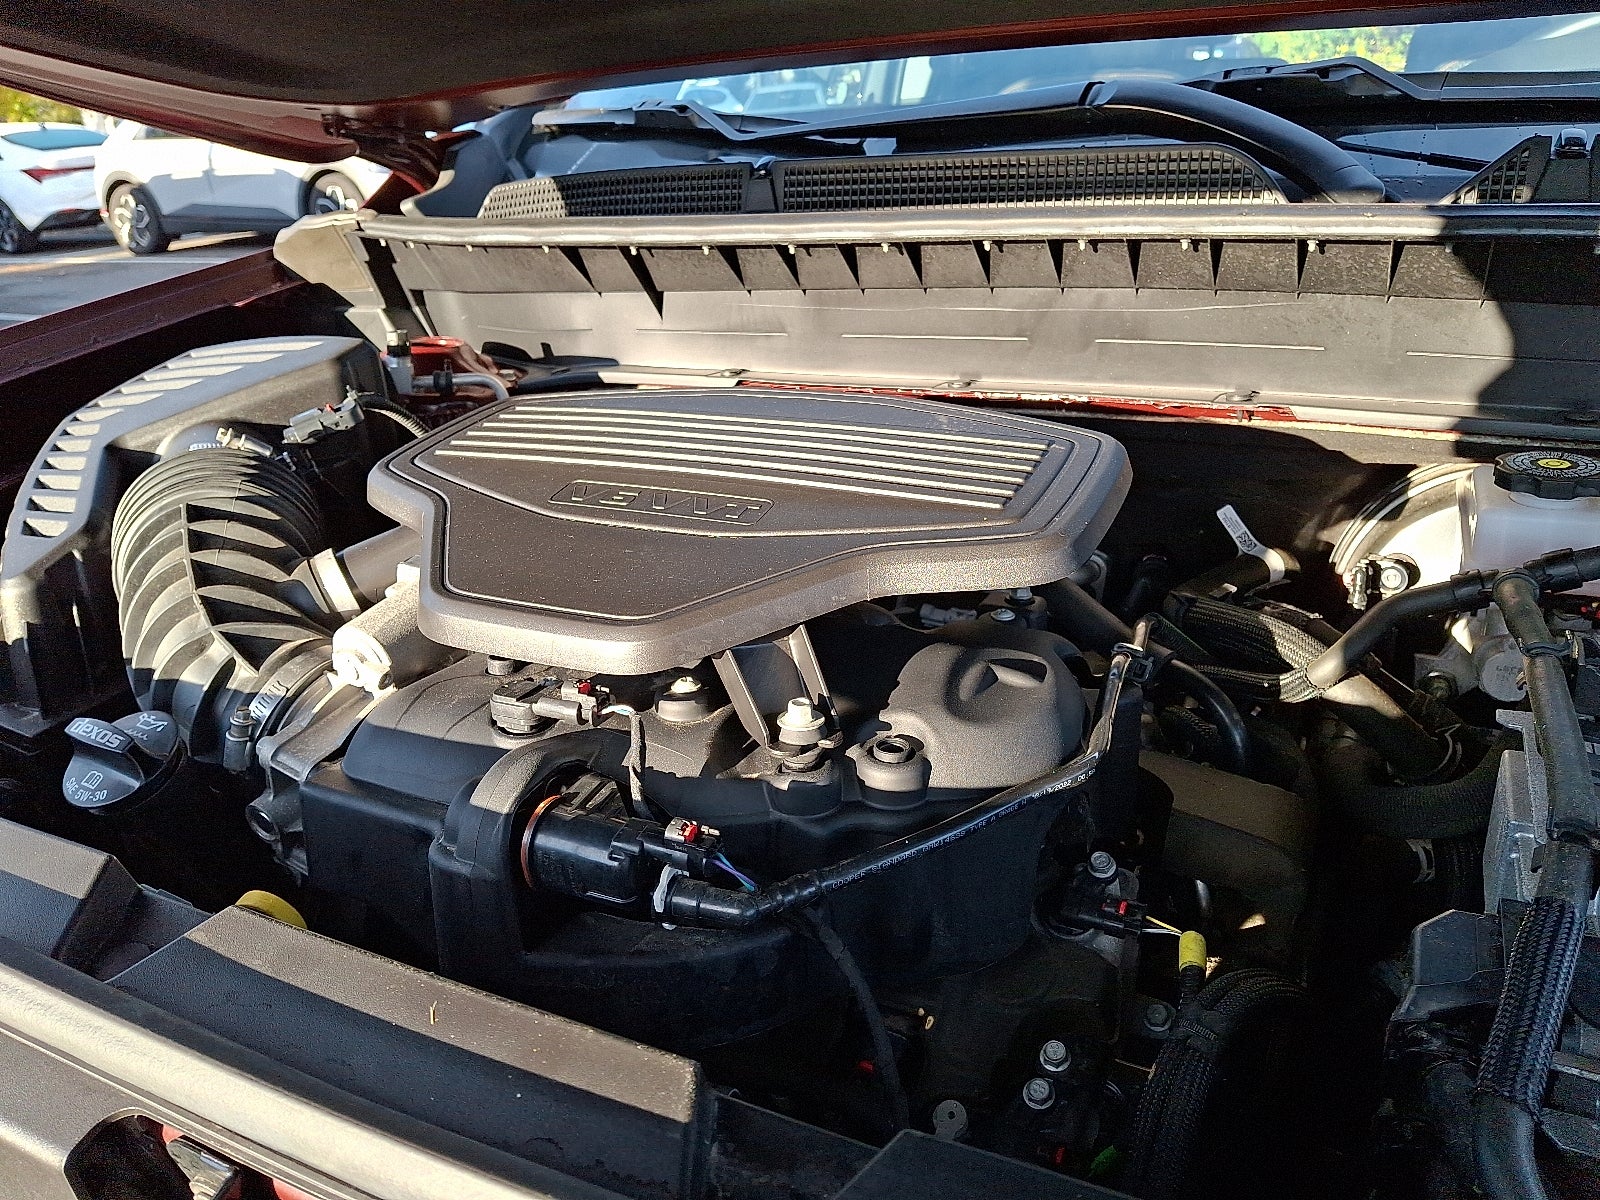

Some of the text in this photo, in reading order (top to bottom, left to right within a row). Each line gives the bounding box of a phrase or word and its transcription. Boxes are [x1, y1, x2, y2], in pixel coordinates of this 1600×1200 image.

[69, 720, 126, 749] dexos
[66, 777, 108, 802] SAE 5W-30
